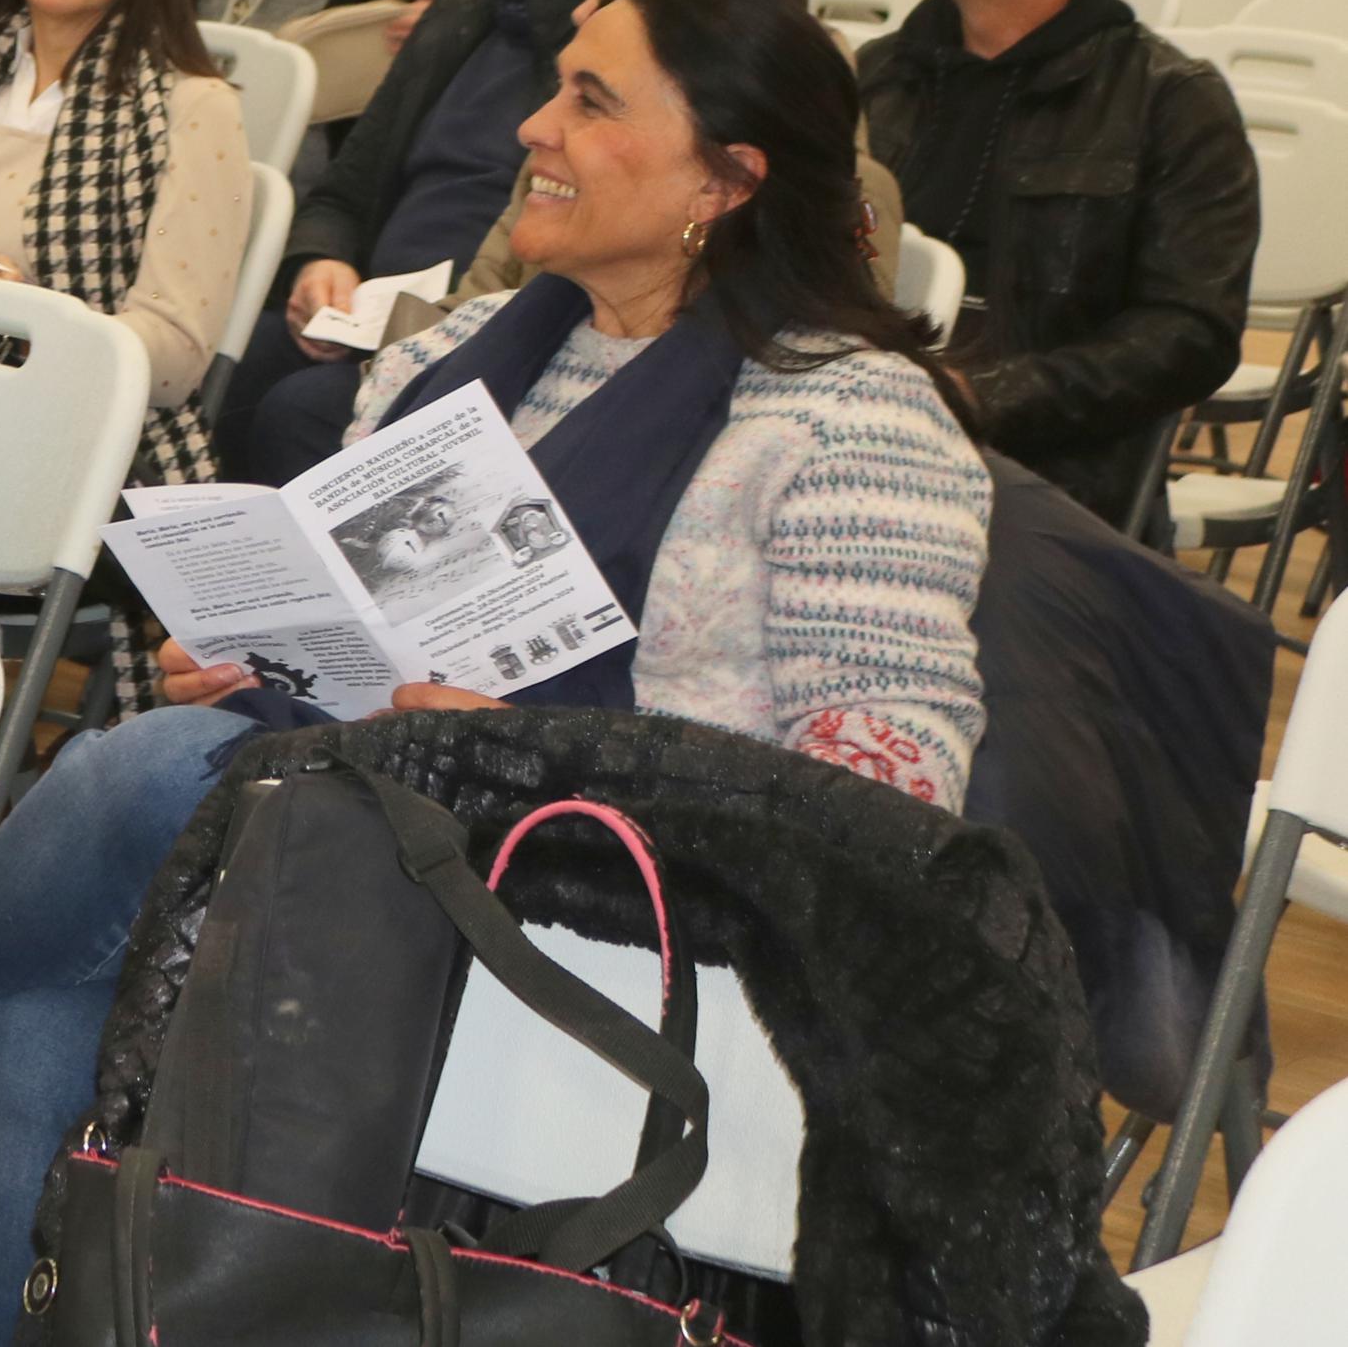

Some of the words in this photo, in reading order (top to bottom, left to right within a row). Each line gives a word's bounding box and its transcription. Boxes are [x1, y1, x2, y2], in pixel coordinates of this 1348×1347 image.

[308, 465, 364, 500] CONCIERTO
[426, 420, 452, 436] cargo
[455, 412, 466, 421] de
[467, 405, 477, 414] la
[314, 486, 348, 508] BANDA
[350, 479, 361, 488] de
[403, 429, 456, 460] COMARCAL
[460, 421, 470, 430] de
[387, 451, 438, 479] CULTURAL
[440, 427, 482, 453] JUVENIL
